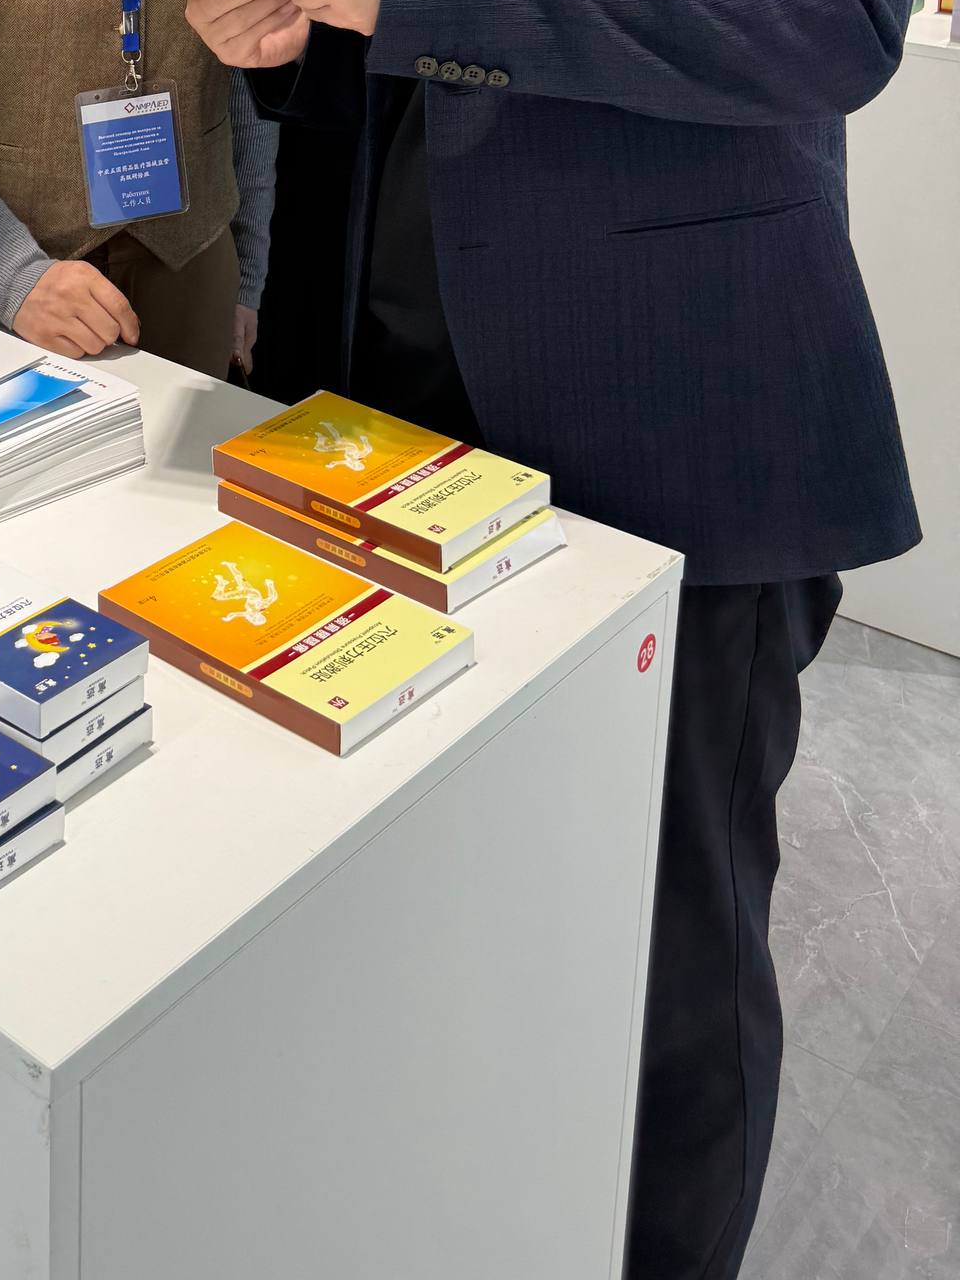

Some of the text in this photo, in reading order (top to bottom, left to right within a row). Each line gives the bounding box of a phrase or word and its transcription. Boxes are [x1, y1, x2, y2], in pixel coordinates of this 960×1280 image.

[308, 625, 400, 683] 穴位压力刺激贴
[641, 639, 654, 669] 28
